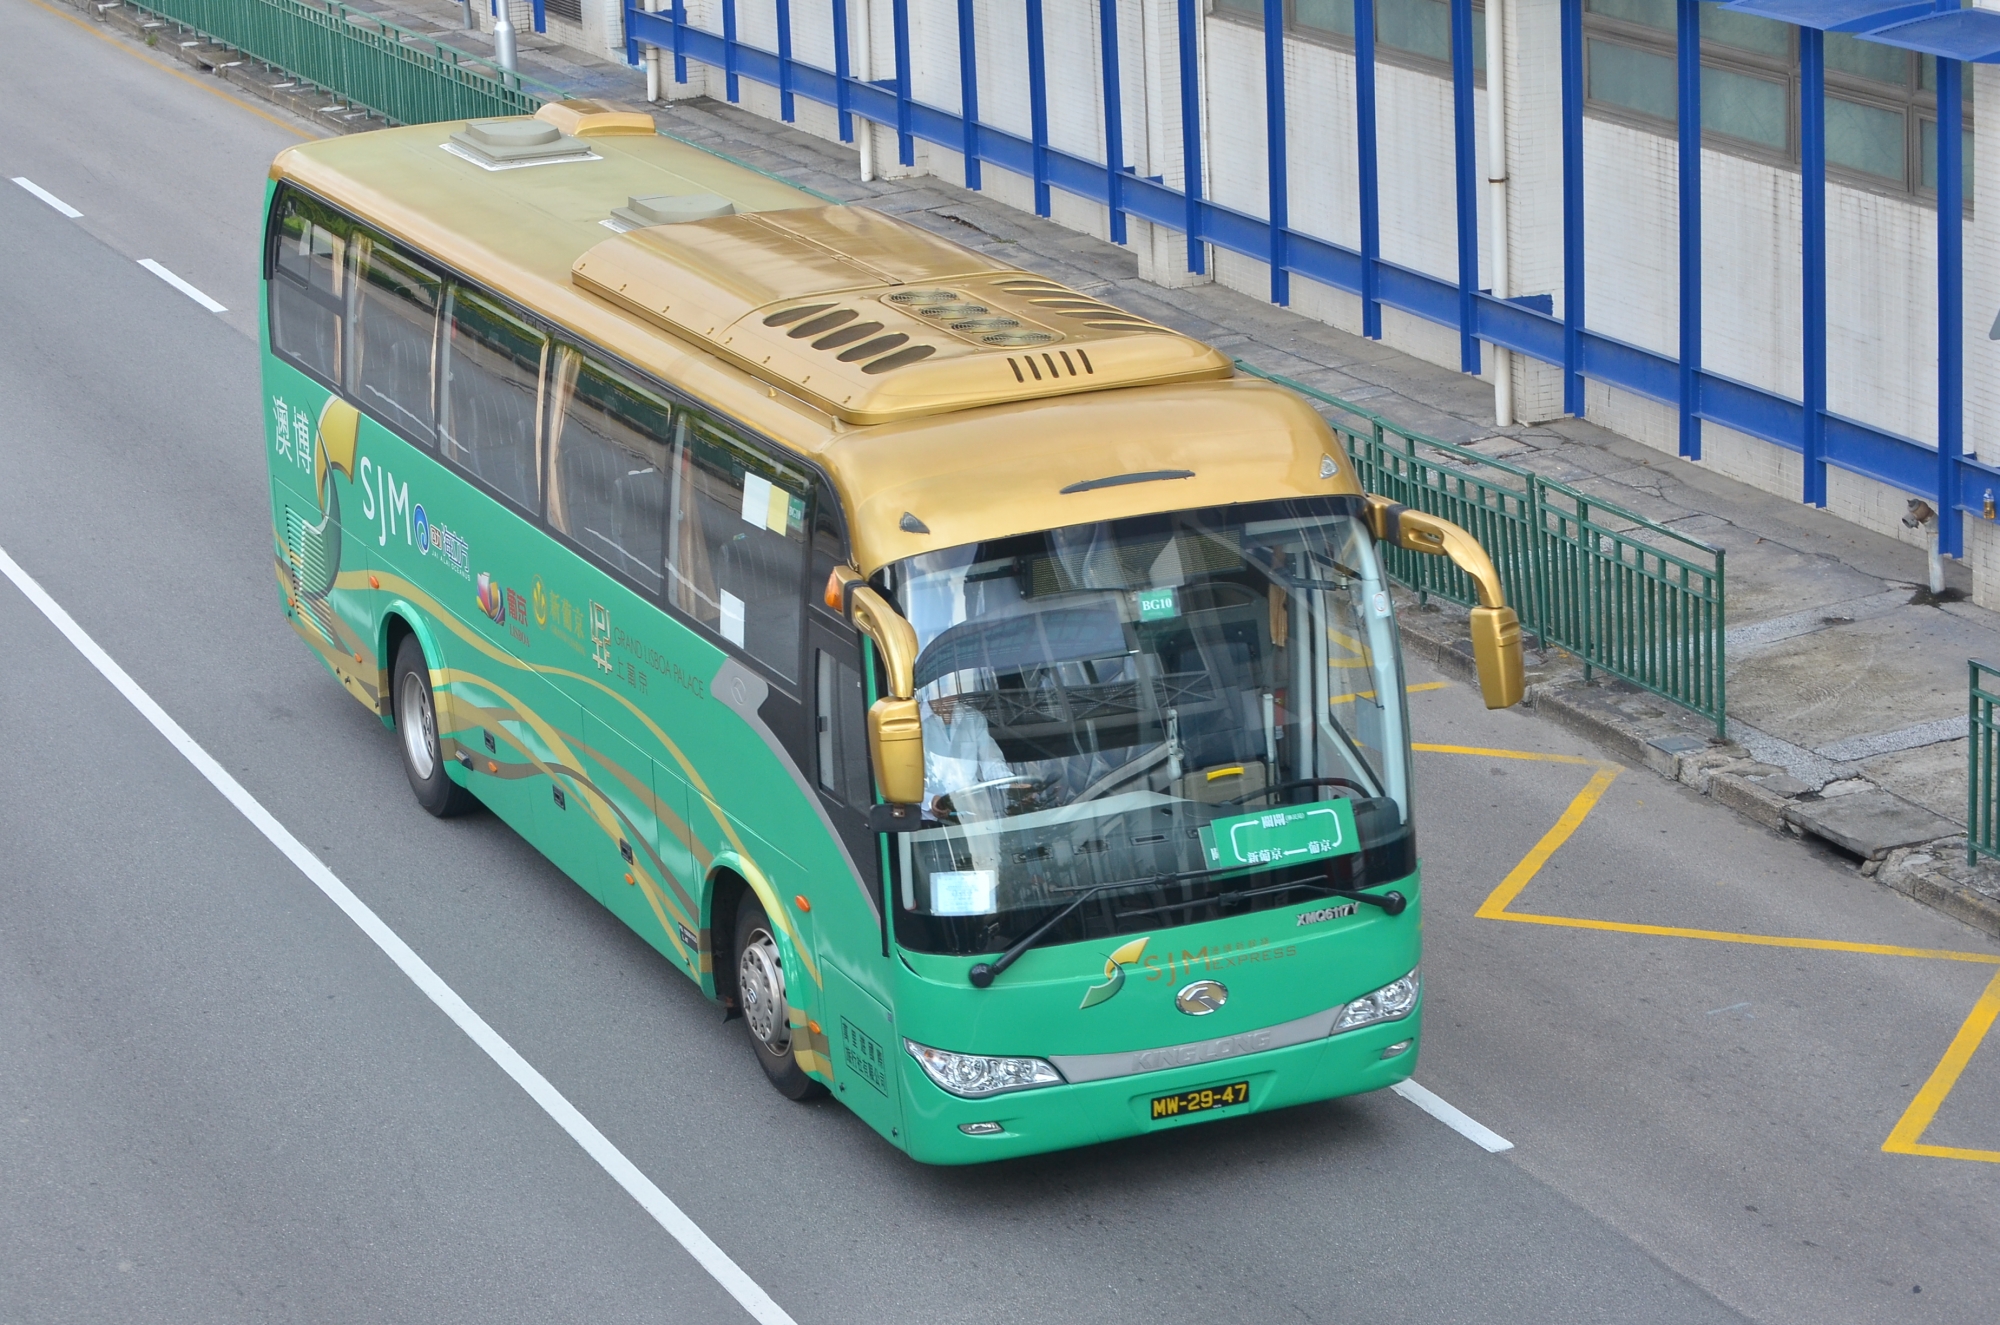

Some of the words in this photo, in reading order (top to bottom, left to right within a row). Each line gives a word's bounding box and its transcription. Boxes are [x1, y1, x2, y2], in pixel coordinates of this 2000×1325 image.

[272, 395, 312, 475] 澳博
[360, 456, 412, 547] SJM
[451, 563, 471, 581] OCEANUS
[506, 587, 529, 628] 葡京
[549, 588, 585, 639] 新葡京
[1142, 598, 1173, 611] BG10
[614, 626, 643, 660] GRAND
[643, 645, 672, 679] LISBOA
[673, 663, 704, 700] PALACE
[1247, 847, 1283, 864] 新葡京
[1307, 839, 1332, 854] 葡京
[1296, 901, 1361, 927] XMQ6117Y
[1143, 945, 1211, 987] SJM
[1212, 945, 1297, 971] EXPRESS
[1198, 1030, 1271, 1061] LONG
[1152, 1083, 1248, 1118] MW-29-47
